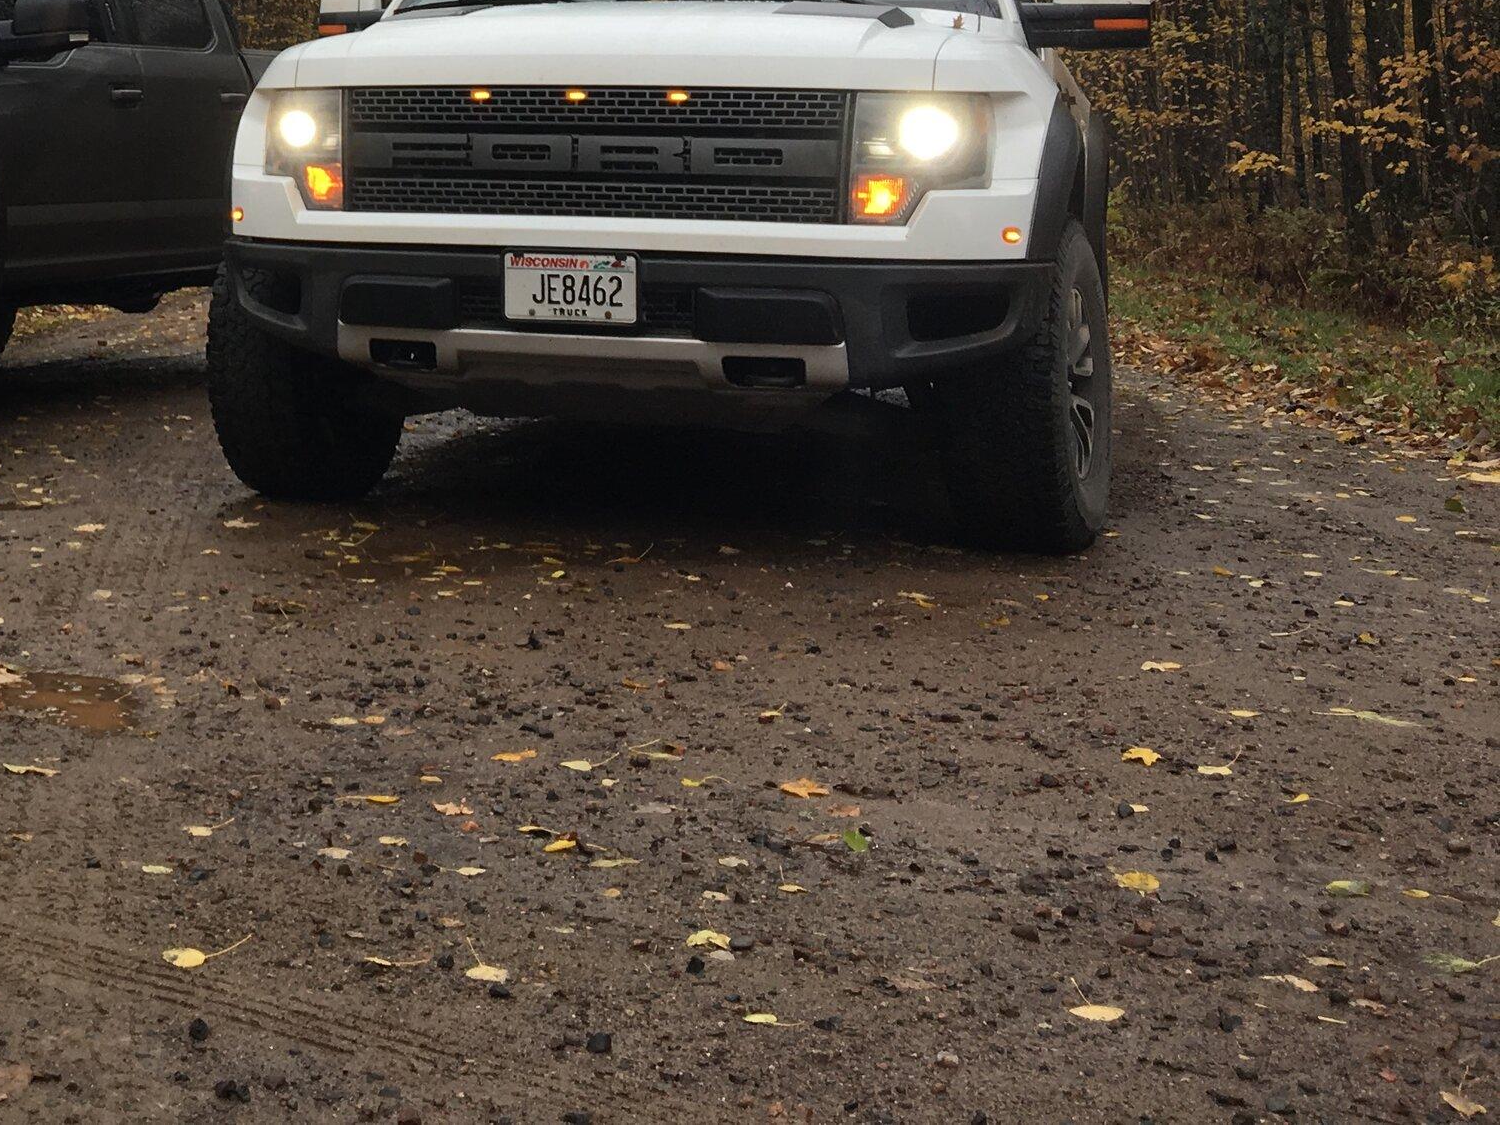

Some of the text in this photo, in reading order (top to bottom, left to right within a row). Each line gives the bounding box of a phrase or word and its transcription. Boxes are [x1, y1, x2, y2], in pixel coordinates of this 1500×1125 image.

[358, 131, 825, 176] FORD
[510, 255, 578, 269] WISCONSIN
[532, 273, 623, 308] JE8462
[553, 308, 588, 317] TRUCK
